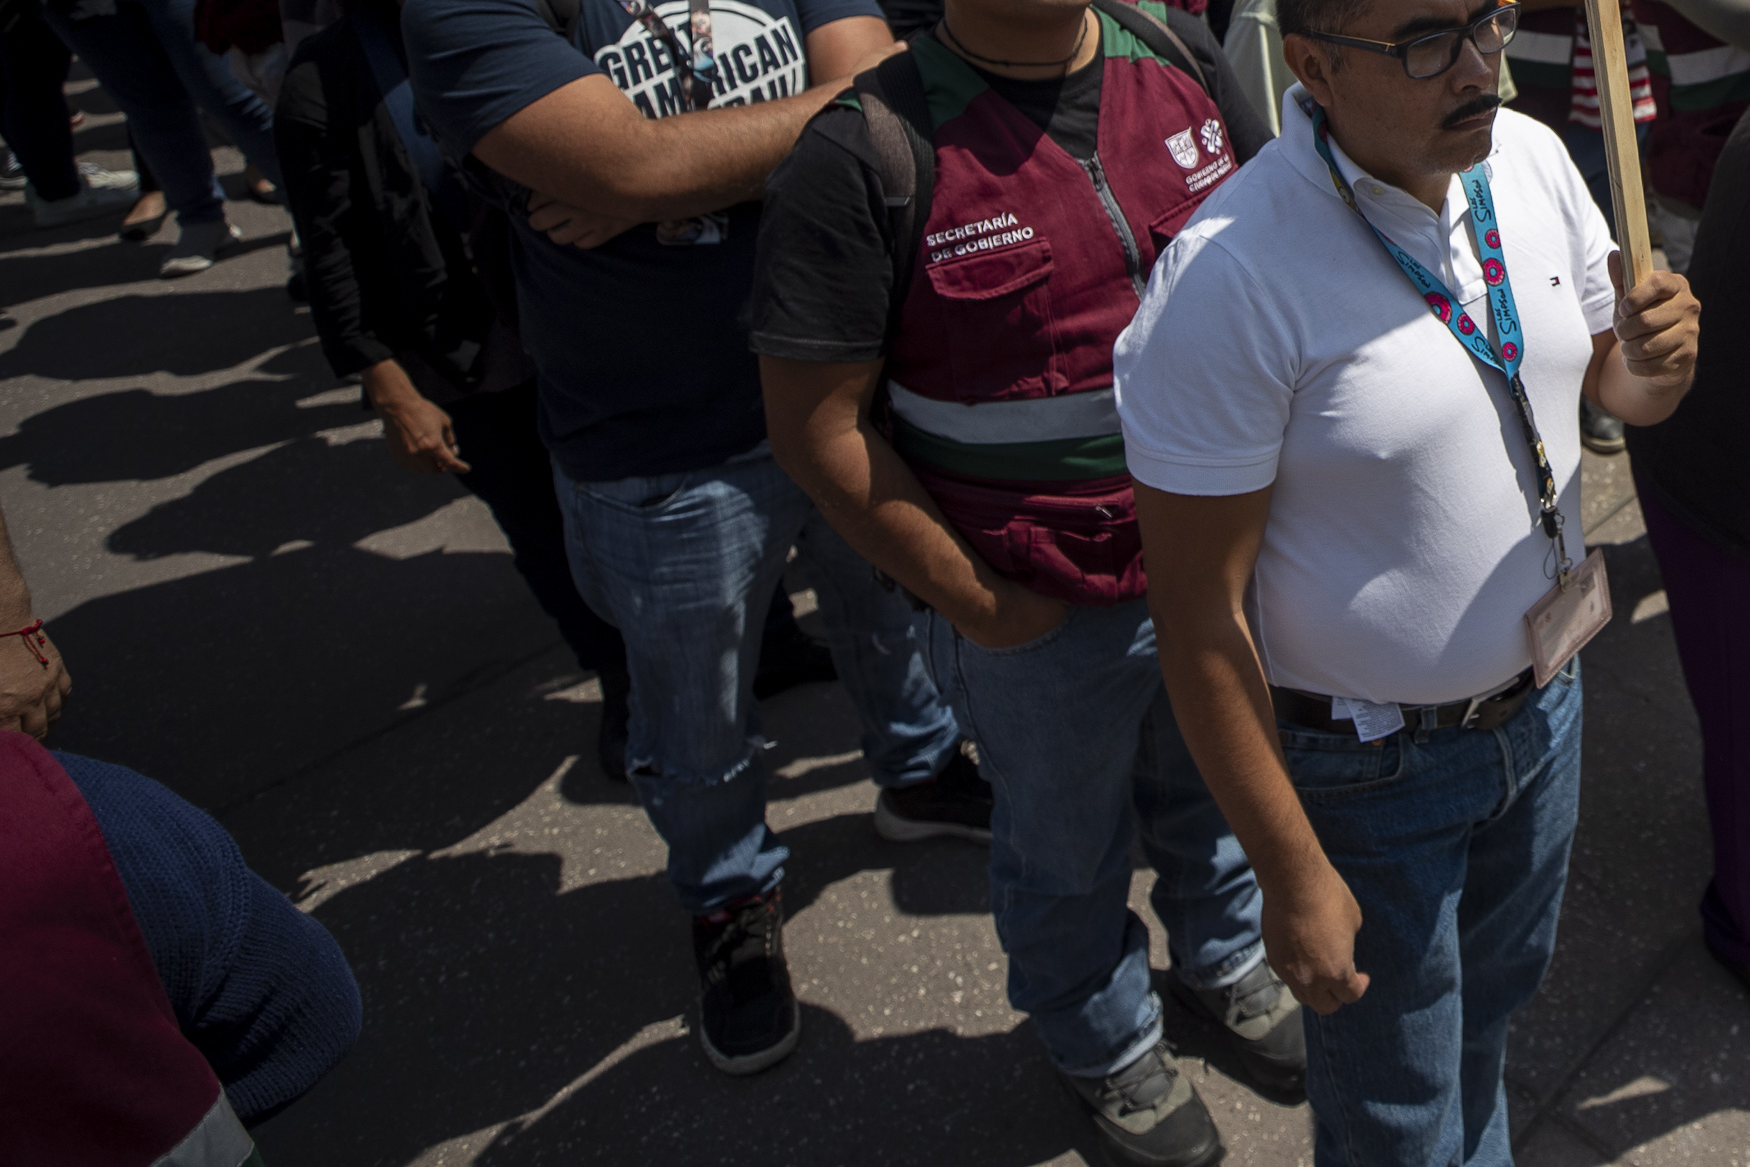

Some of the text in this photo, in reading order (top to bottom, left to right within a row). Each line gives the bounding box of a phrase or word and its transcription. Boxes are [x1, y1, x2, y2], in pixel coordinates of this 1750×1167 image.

[926, 212, 1019, 247] SECRETARÍA
[931, 226, 1034, 263] DE GOBIERNO
